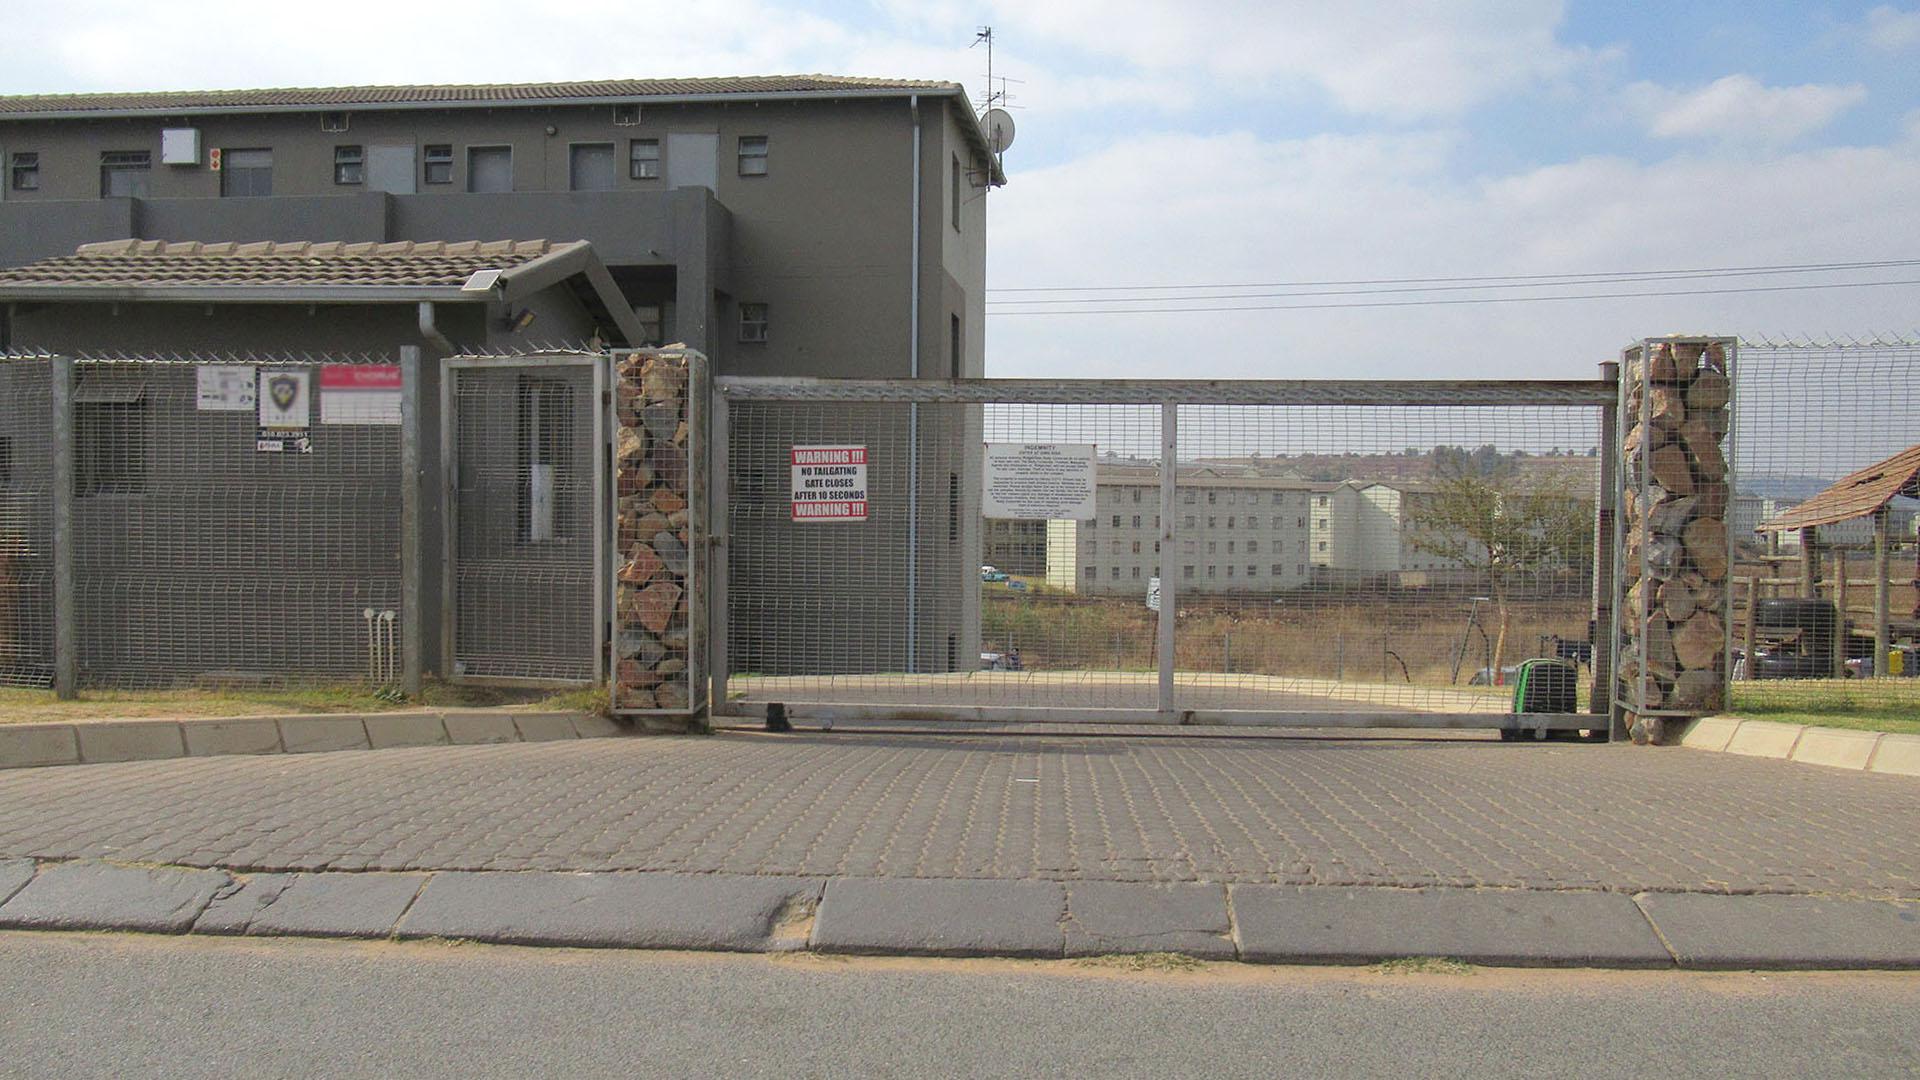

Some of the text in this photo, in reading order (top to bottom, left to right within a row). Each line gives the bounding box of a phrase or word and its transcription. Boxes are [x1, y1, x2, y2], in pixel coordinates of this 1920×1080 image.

[795, 450, 864, 463] WARNING !!!
[801, 466, 857, 476] NO TAILGATING
[805, 478, 854, 488] GATE CLOSES
[794, 490, 865, 500] AFTER 10 SECONDS
[795, 502, 864, 516] WARNING !!!
